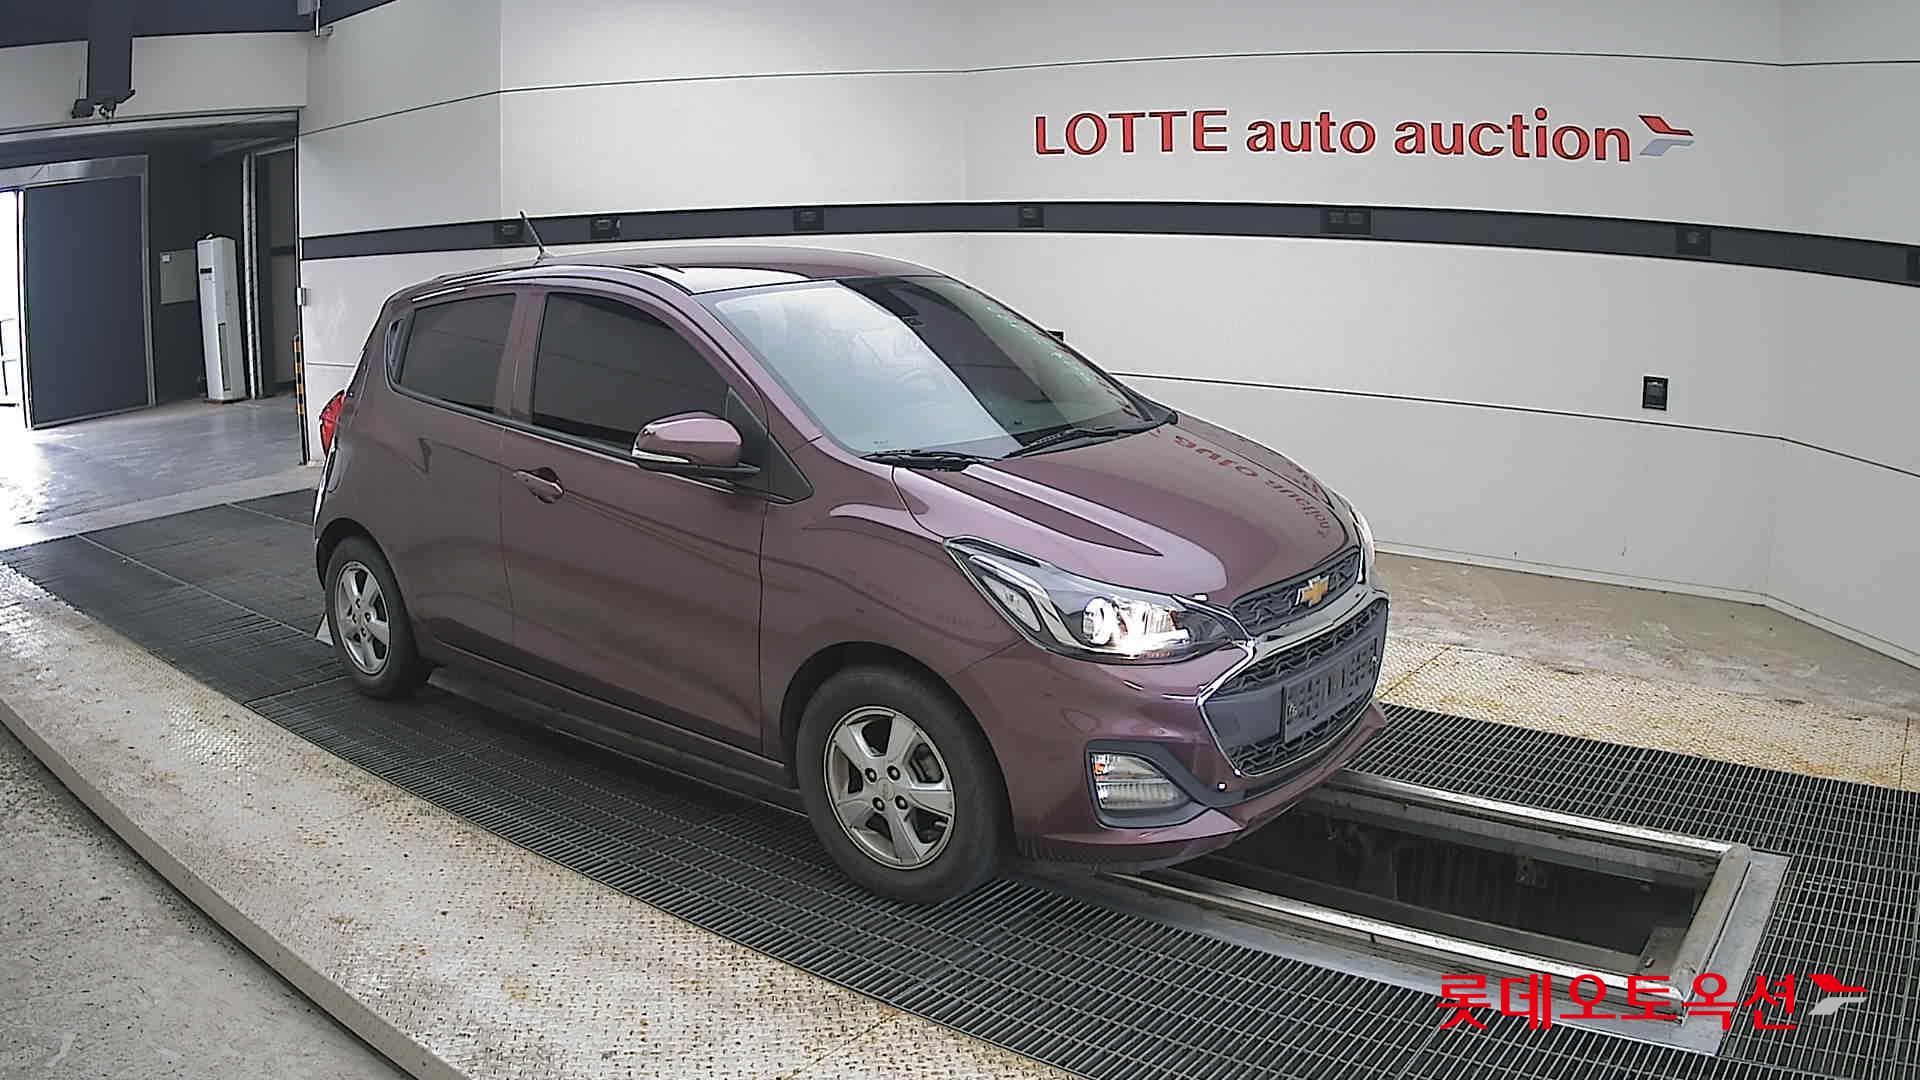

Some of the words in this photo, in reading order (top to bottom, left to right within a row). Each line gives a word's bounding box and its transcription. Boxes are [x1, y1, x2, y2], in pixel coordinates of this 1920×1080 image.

[1034, 109, 1229, 156] LOTTE
[1245, 110, 1377, 156] auto
[1393, 106, 1632, 163] auction
